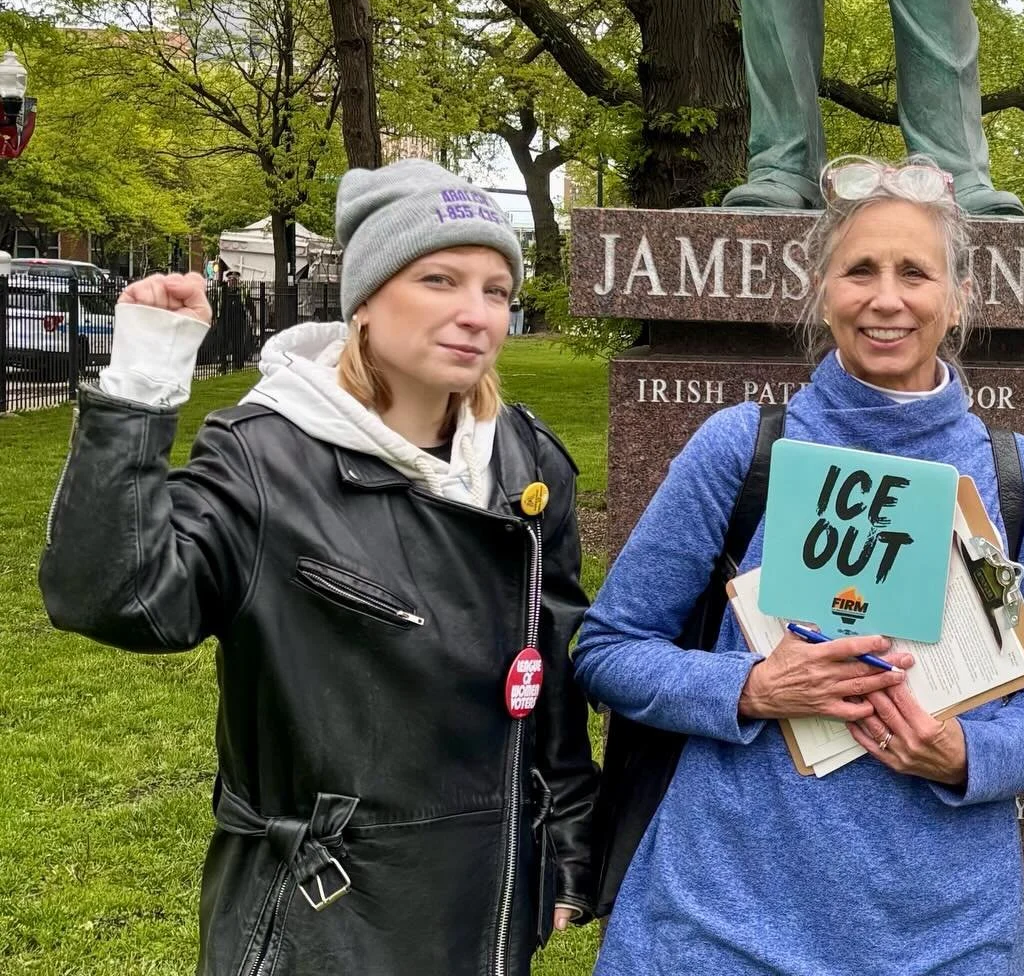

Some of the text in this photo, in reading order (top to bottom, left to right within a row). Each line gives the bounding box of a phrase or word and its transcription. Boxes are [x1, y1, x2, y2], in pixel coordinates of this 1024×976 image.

[594, 233, 810, 300] JAMES
[637, 378, 724, 404] IRISH
[743, 380, 812, 405] PAT
[816, 465, 911, 527] ICE
[803, 518, 914, 584] OUT
[831, 597, 869, 613] FIRM
[510, 696, 537, 711] VOTERS
[511, 684, 540, 697] WOMEN
